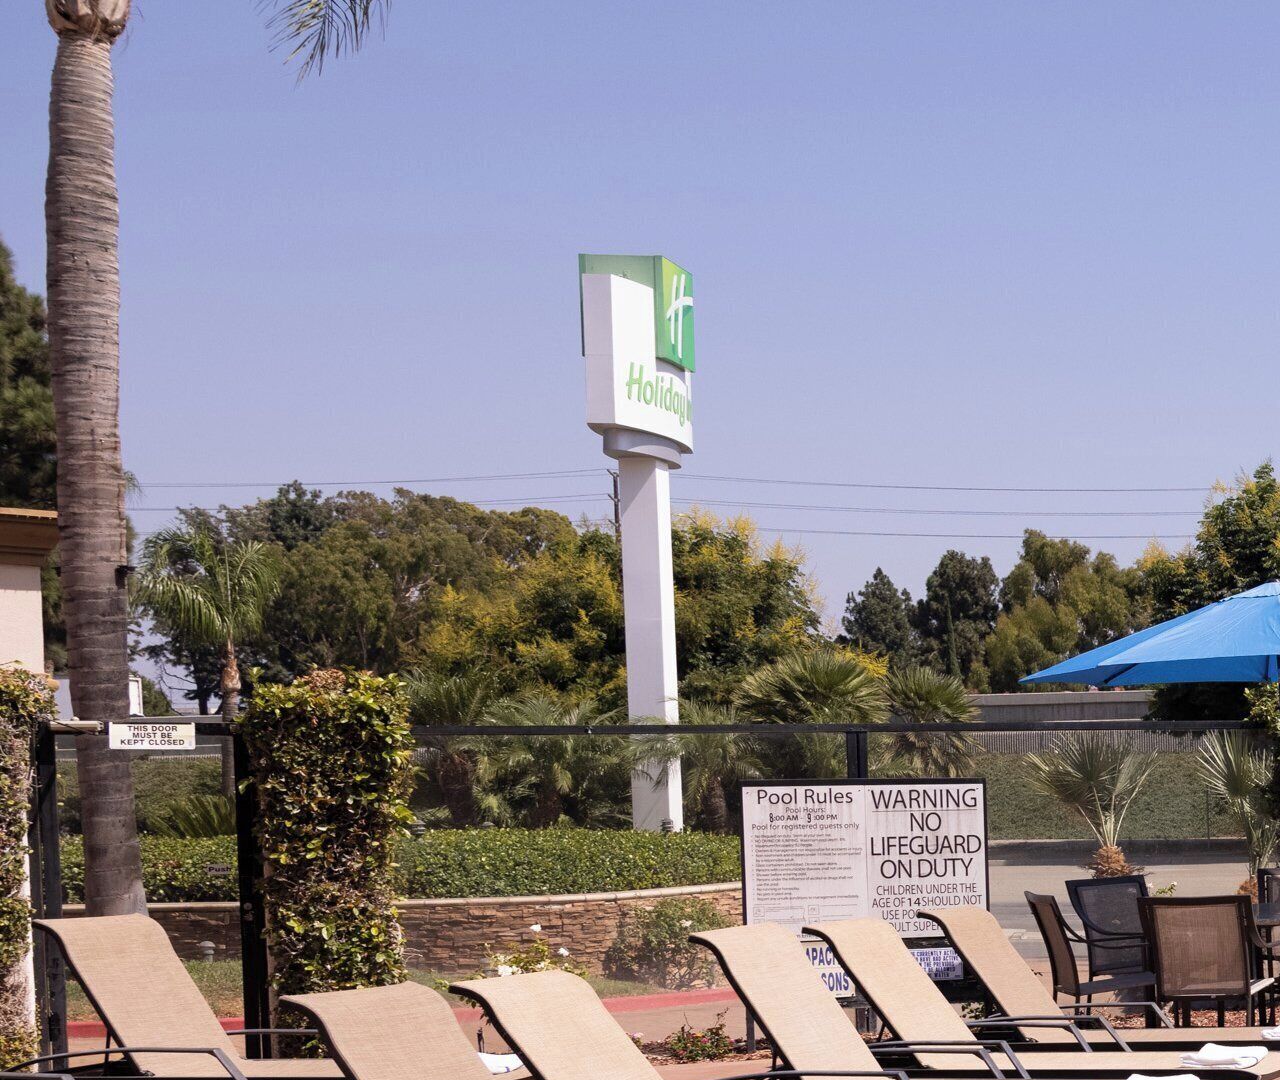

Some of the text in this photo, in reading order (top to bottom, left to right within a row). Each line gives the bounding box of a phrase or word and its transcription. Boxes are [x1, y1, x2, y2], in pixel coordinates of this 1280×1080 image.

[626, 362, 685, 427] Holiday
[757, 788, 853, 804] Pool Rules
[871, 788, 977, 809] WARNING
[769, 813, 785, 822] 8:00
[910, 812, 942, 831] NO
[782, 823, 818, 831] registered
[844, 822, 859, 830] only
[871, 835, 982, 856] LIFEGUARD
[880, 858, 973, 878] ON DUTY
[876, 883, 976, 895] CHILDREN UNDER THE
[872, 895, 982, 908] AGE OF 14 SHOULD NOT
[882, 909, 900, 920] USE
[889, 922, 911, 932] DULT
[822, 972, 849, 992] SONS
